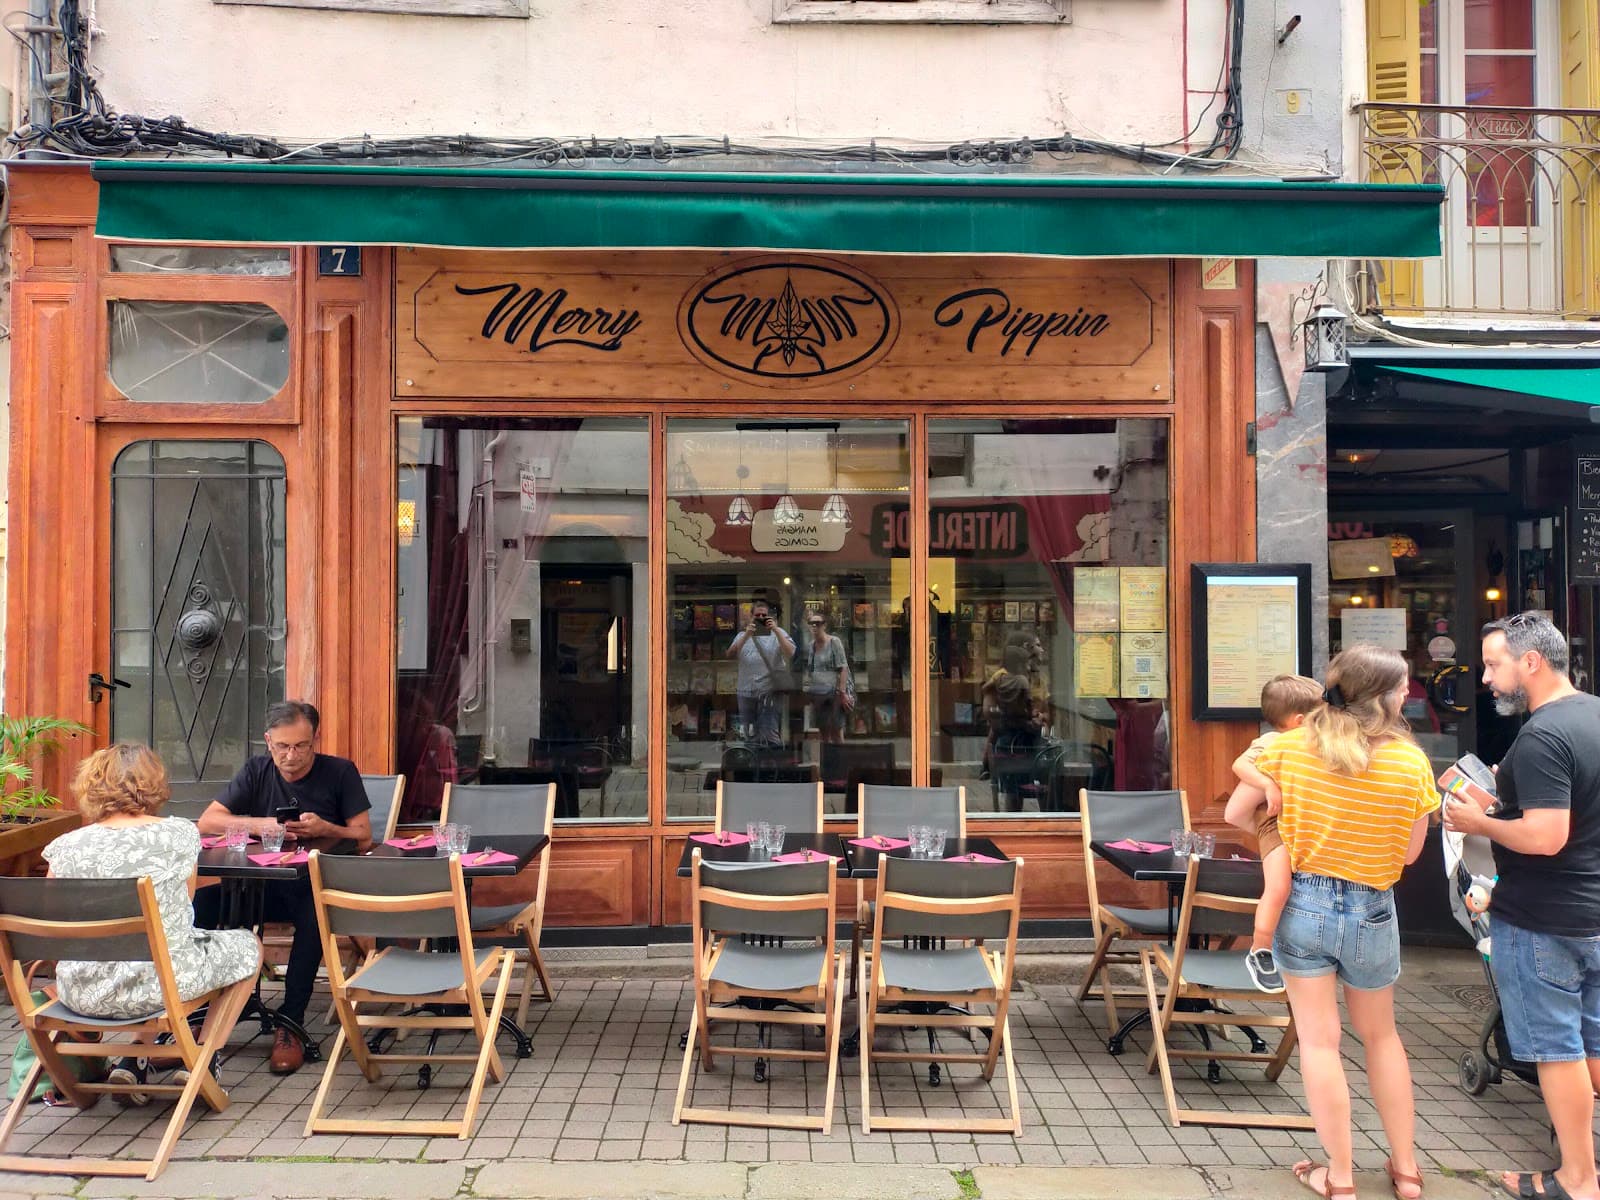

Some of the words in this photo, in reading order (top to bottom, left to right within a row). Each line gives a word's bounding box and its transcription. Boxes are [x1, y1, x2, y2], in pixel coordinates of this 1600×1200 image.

[1287, 90, 1299, 114] 9
[1489, 119, 1517, 134] 1846
[332, 248, 347, 273] 7
[455, 283, 642, 352] Merry
[934, 288, 1110, 357] Pippin
